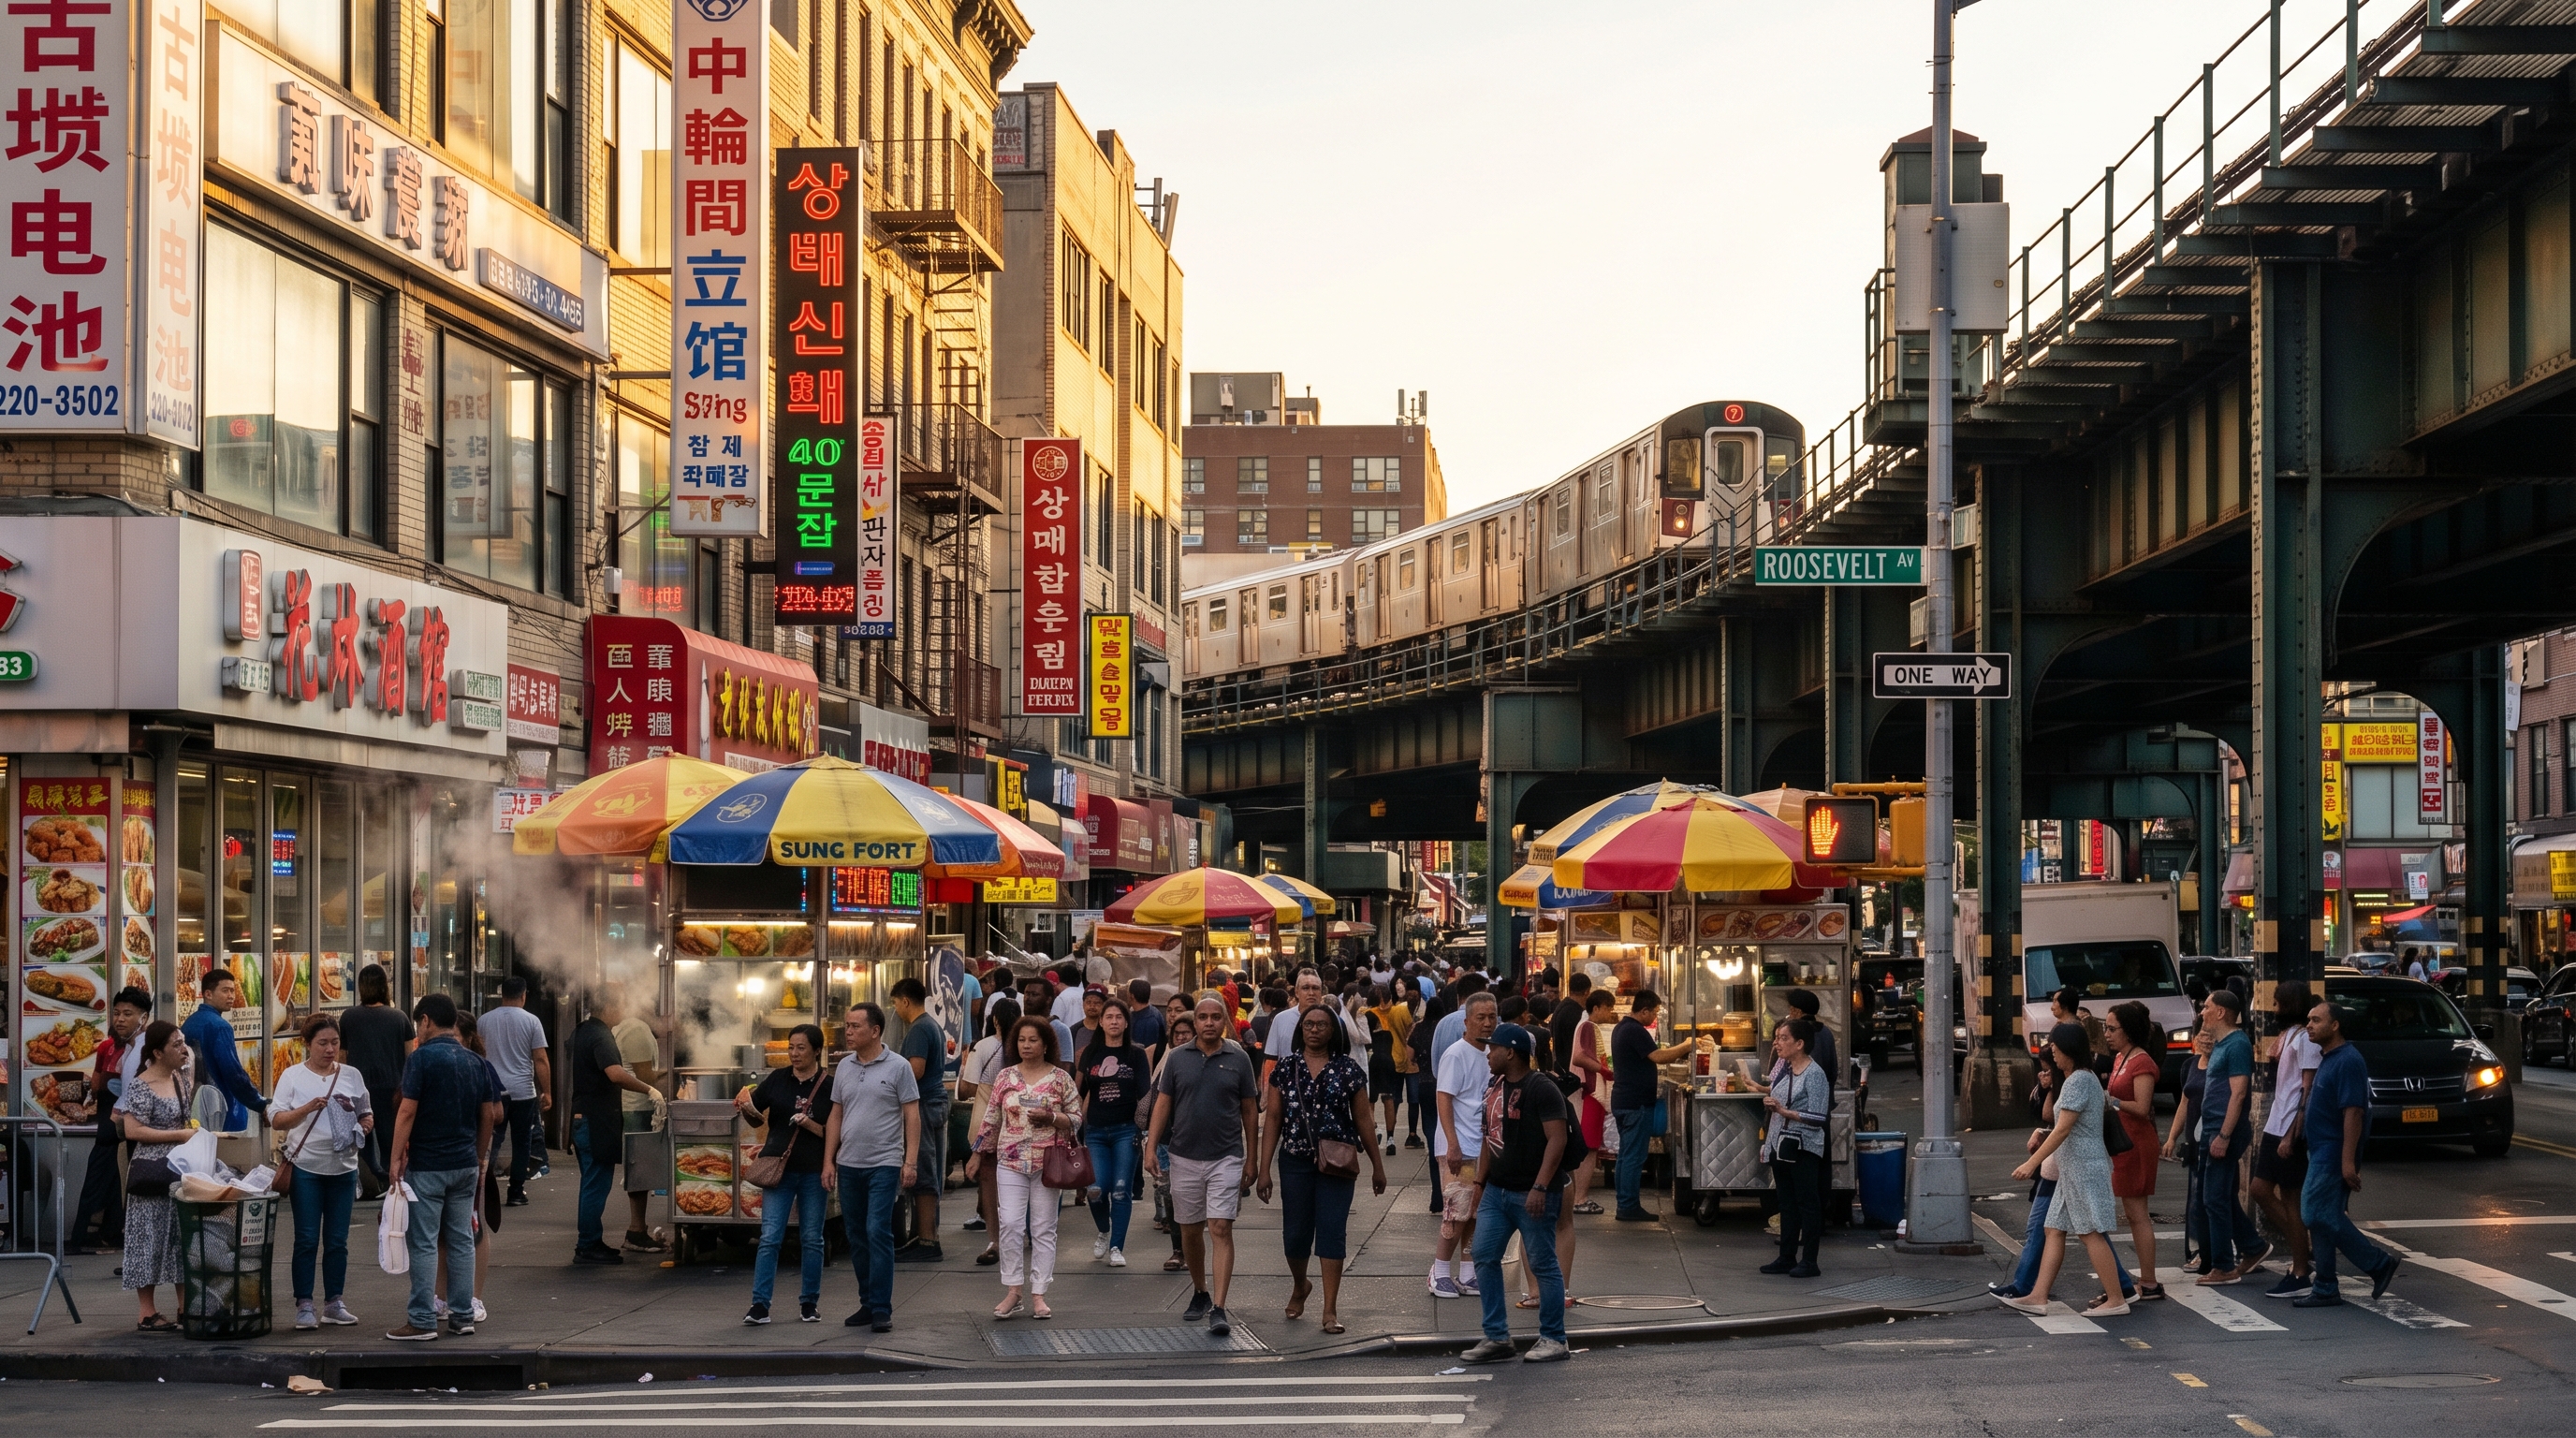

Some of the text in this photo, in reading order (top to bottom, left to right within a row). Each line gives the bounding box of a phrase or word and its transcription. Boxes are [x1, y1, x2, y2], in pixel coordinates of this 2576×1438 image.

[1731, 408, 1737, 419] 7
[688, 434, 710, 457] 참
[1764, 552, 1887, 580] ROOSEVELT
[1895, 668, 1992, 684] ONE WAY
[781, 842, 916, 858] SUNG FORT
